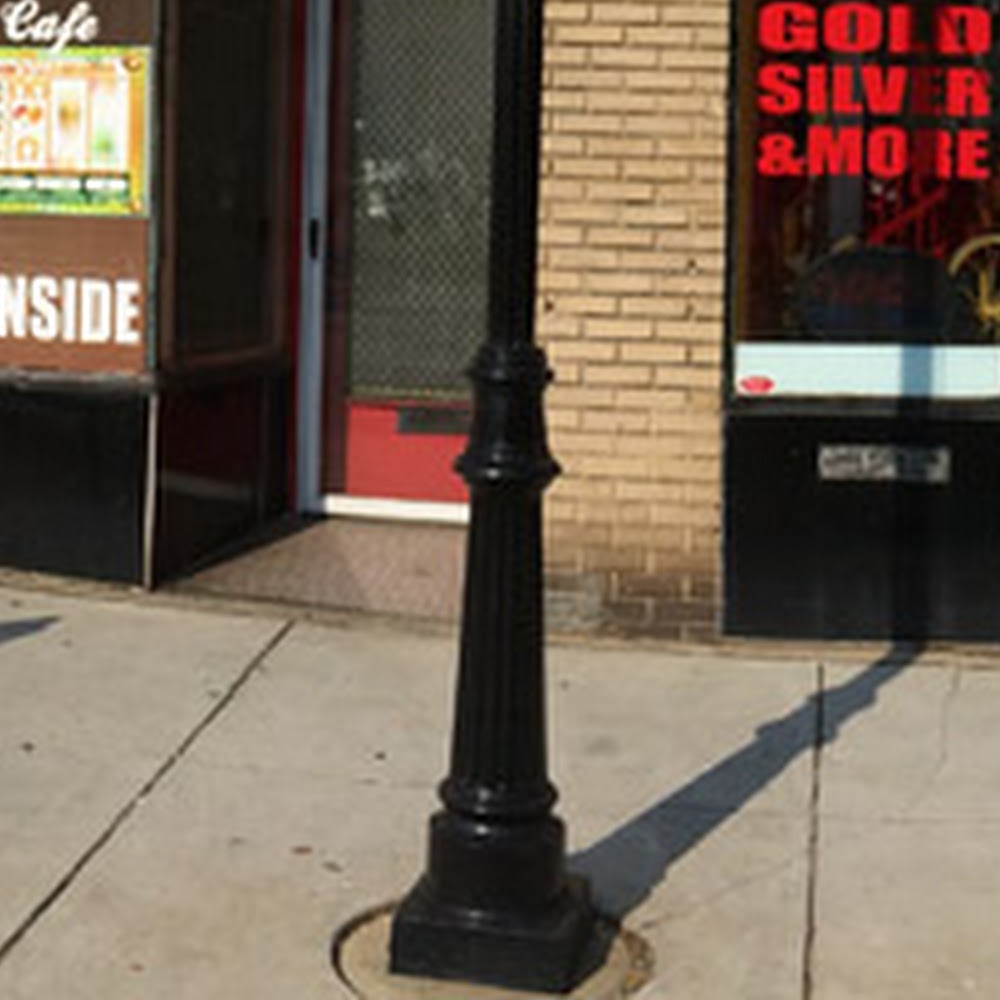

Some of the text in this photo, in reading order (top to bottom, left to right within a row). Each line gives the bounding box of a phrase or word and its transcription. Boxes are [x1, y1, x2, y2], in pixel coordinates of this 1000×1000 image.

[758, 0, 993, 56] GOLD
[757, 61, 992, 118] SILVER
[0, 274, 141, 344] NSIDE
